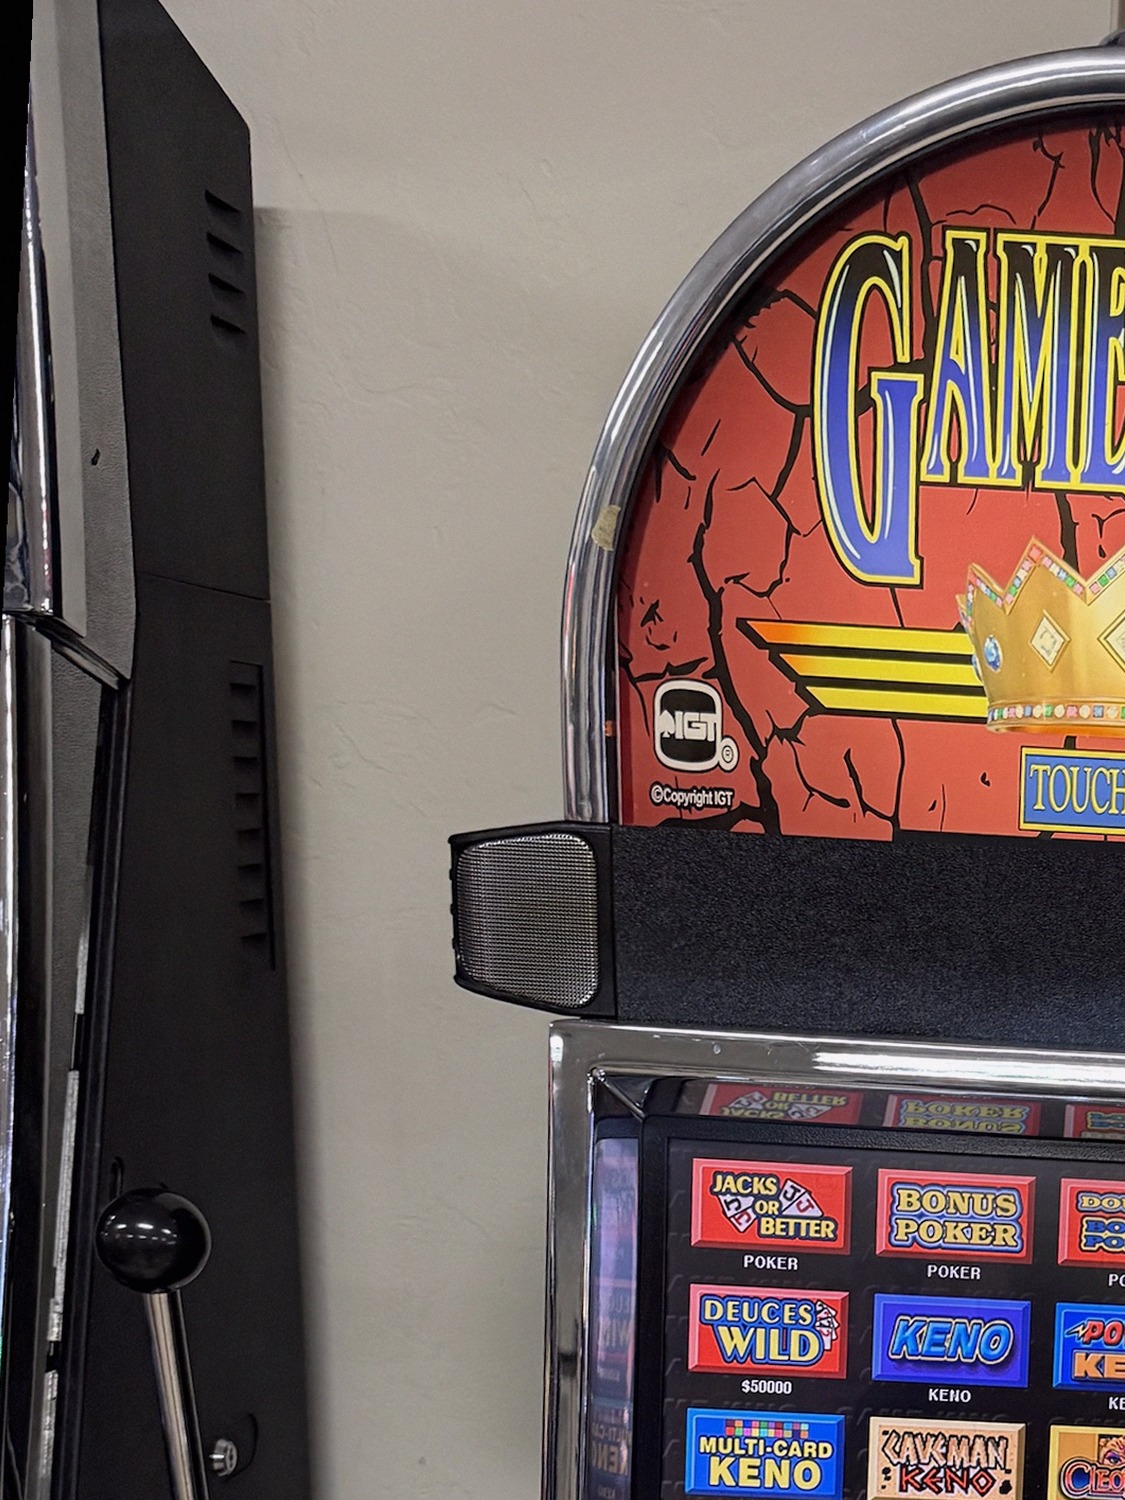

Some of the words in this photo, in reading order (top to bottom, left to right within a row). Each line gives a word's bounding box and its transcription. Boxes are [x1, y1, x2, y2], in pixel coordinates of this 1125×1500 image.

[675, 711, 716, 741] IGT
[714, 791, 733, 806] IGT
[713, 1174, 778, 1196] JACKS
[755, 1200, 780, 1215] OR
[896, 1187, 1017, 1217] BONUS
[760, 1217, 836, 1238] BETTER
[895, 1219, 1017, 1246] POKER
[743, 1254, 799, 1271] POKER
[927, 1265, 981, 1280] POKER
[704, 1298, 814, 1325] DEUCES
[717, 1327, 823, 1362] WILD
[889, 1316, 1014, 1364] KENO
[741, 1379, 792, 1395] $50000
[928, 1388, 971, 1404] KENO
[699, 1436, 833, 1459] MULTI-CARD
[882, 1430, 1008, 1469] CAVEMAN
[709, 1457, 822, 1490] KENO
[899, 1469, 997, 1498] KENO
